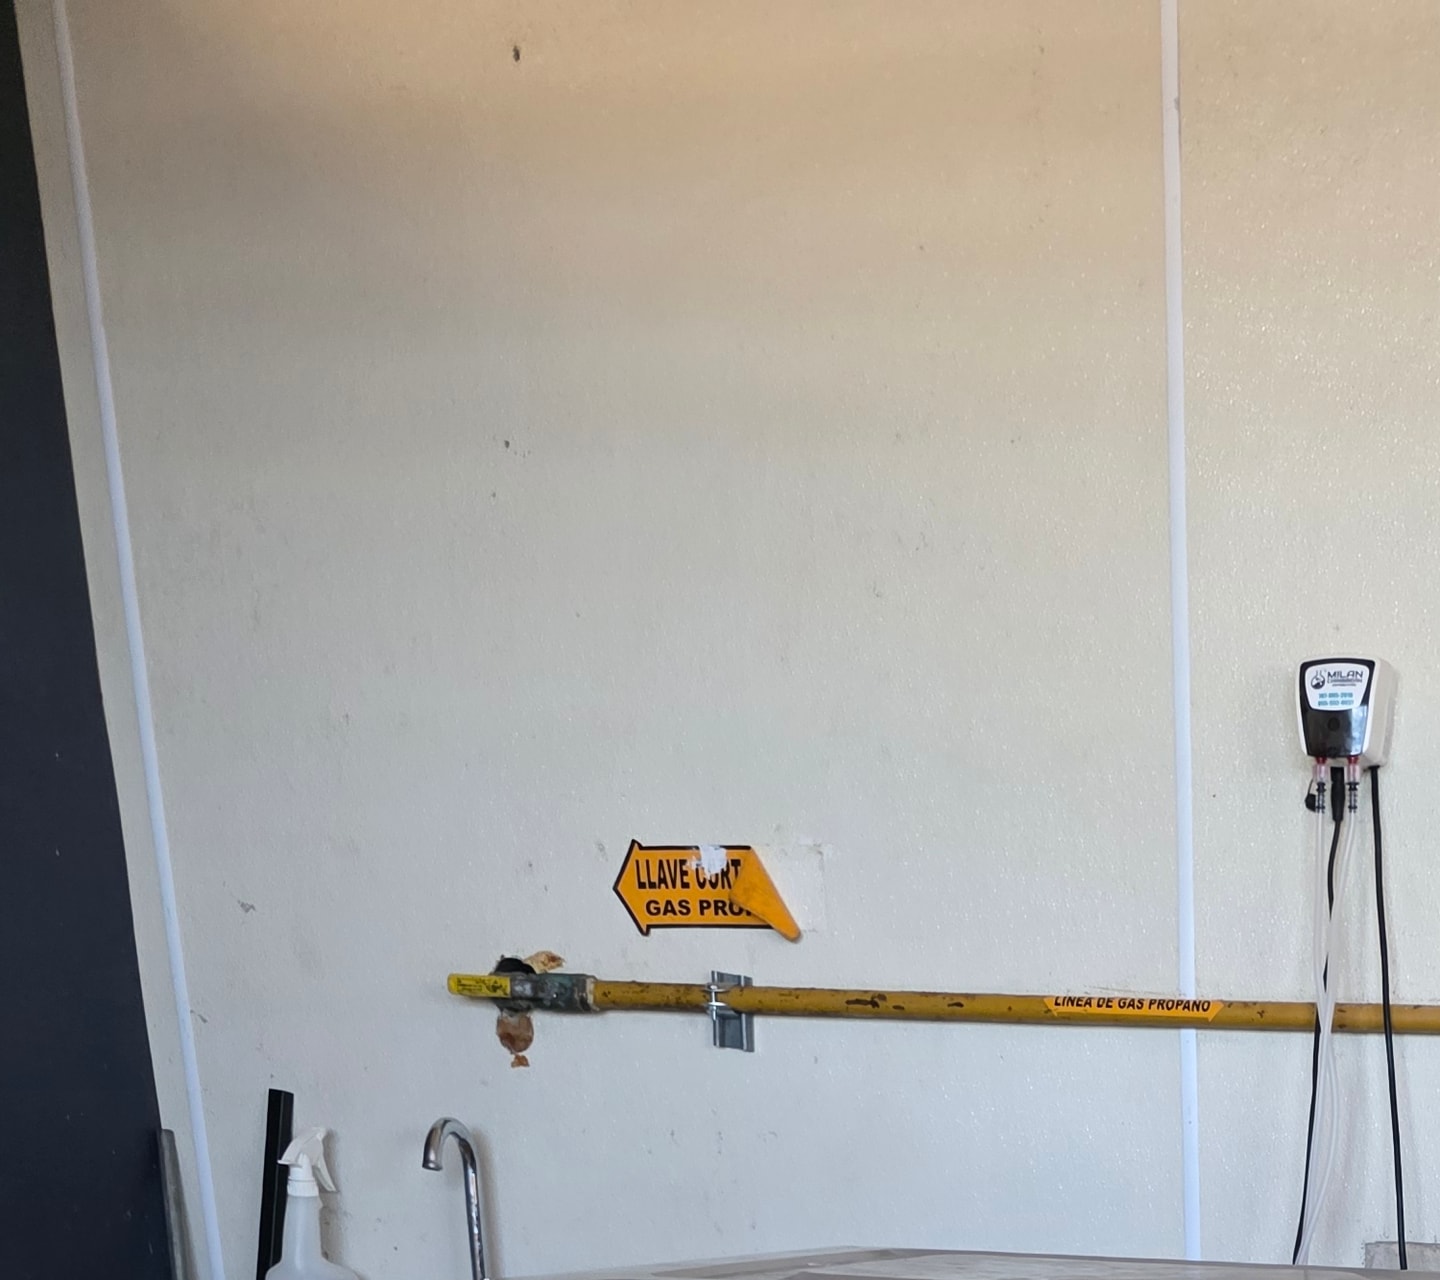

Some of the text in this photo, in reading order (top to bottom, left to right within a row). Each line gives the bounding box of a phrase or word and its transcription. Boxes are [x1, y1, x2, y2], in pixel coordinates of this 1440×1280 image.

[1328, 670, 1364, 679] MILAN
[636, 859, 690, 889] LLAVE
[646, 899, 751, 916] GAS PRO
[1054, 996, 1211, 1012] LINEA DE GAS PROPANO
